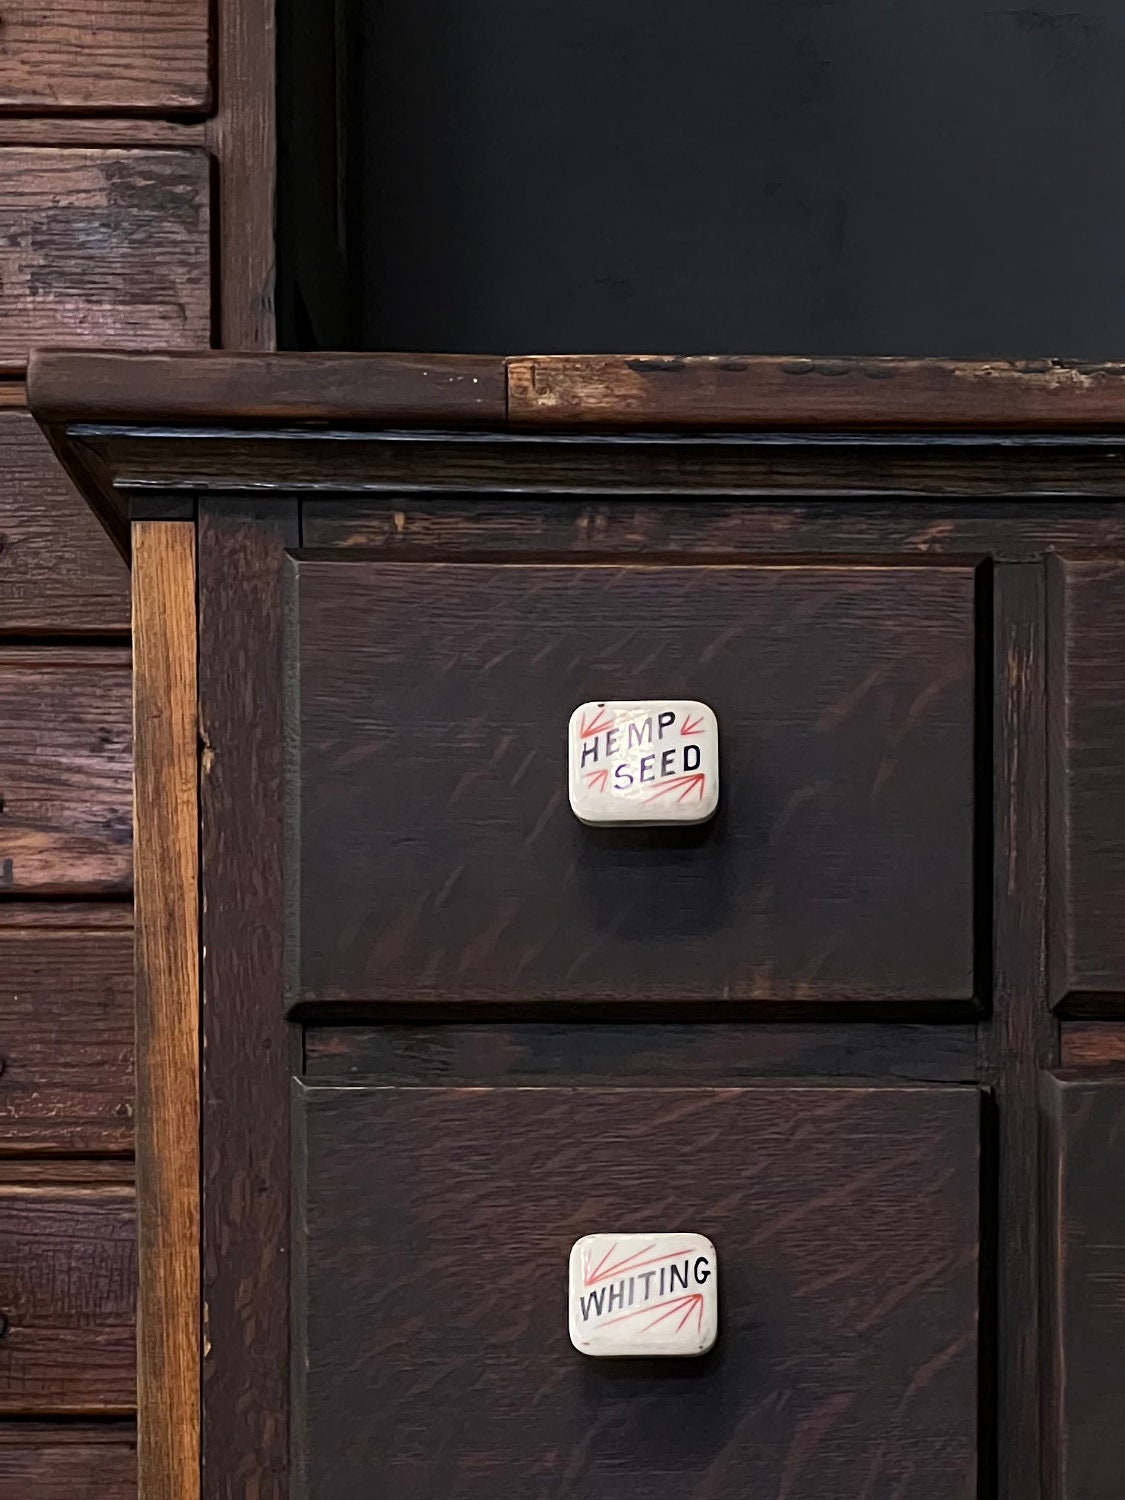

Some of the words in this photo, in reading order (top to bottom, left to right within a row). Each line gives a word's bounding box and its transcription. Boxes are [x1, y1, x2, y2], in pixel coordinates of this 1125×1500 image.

[580, 711, 676, 768] HEMP
[613, 744, 702, 790] SEED
[580, 1256, 711, 1322] WHITING
